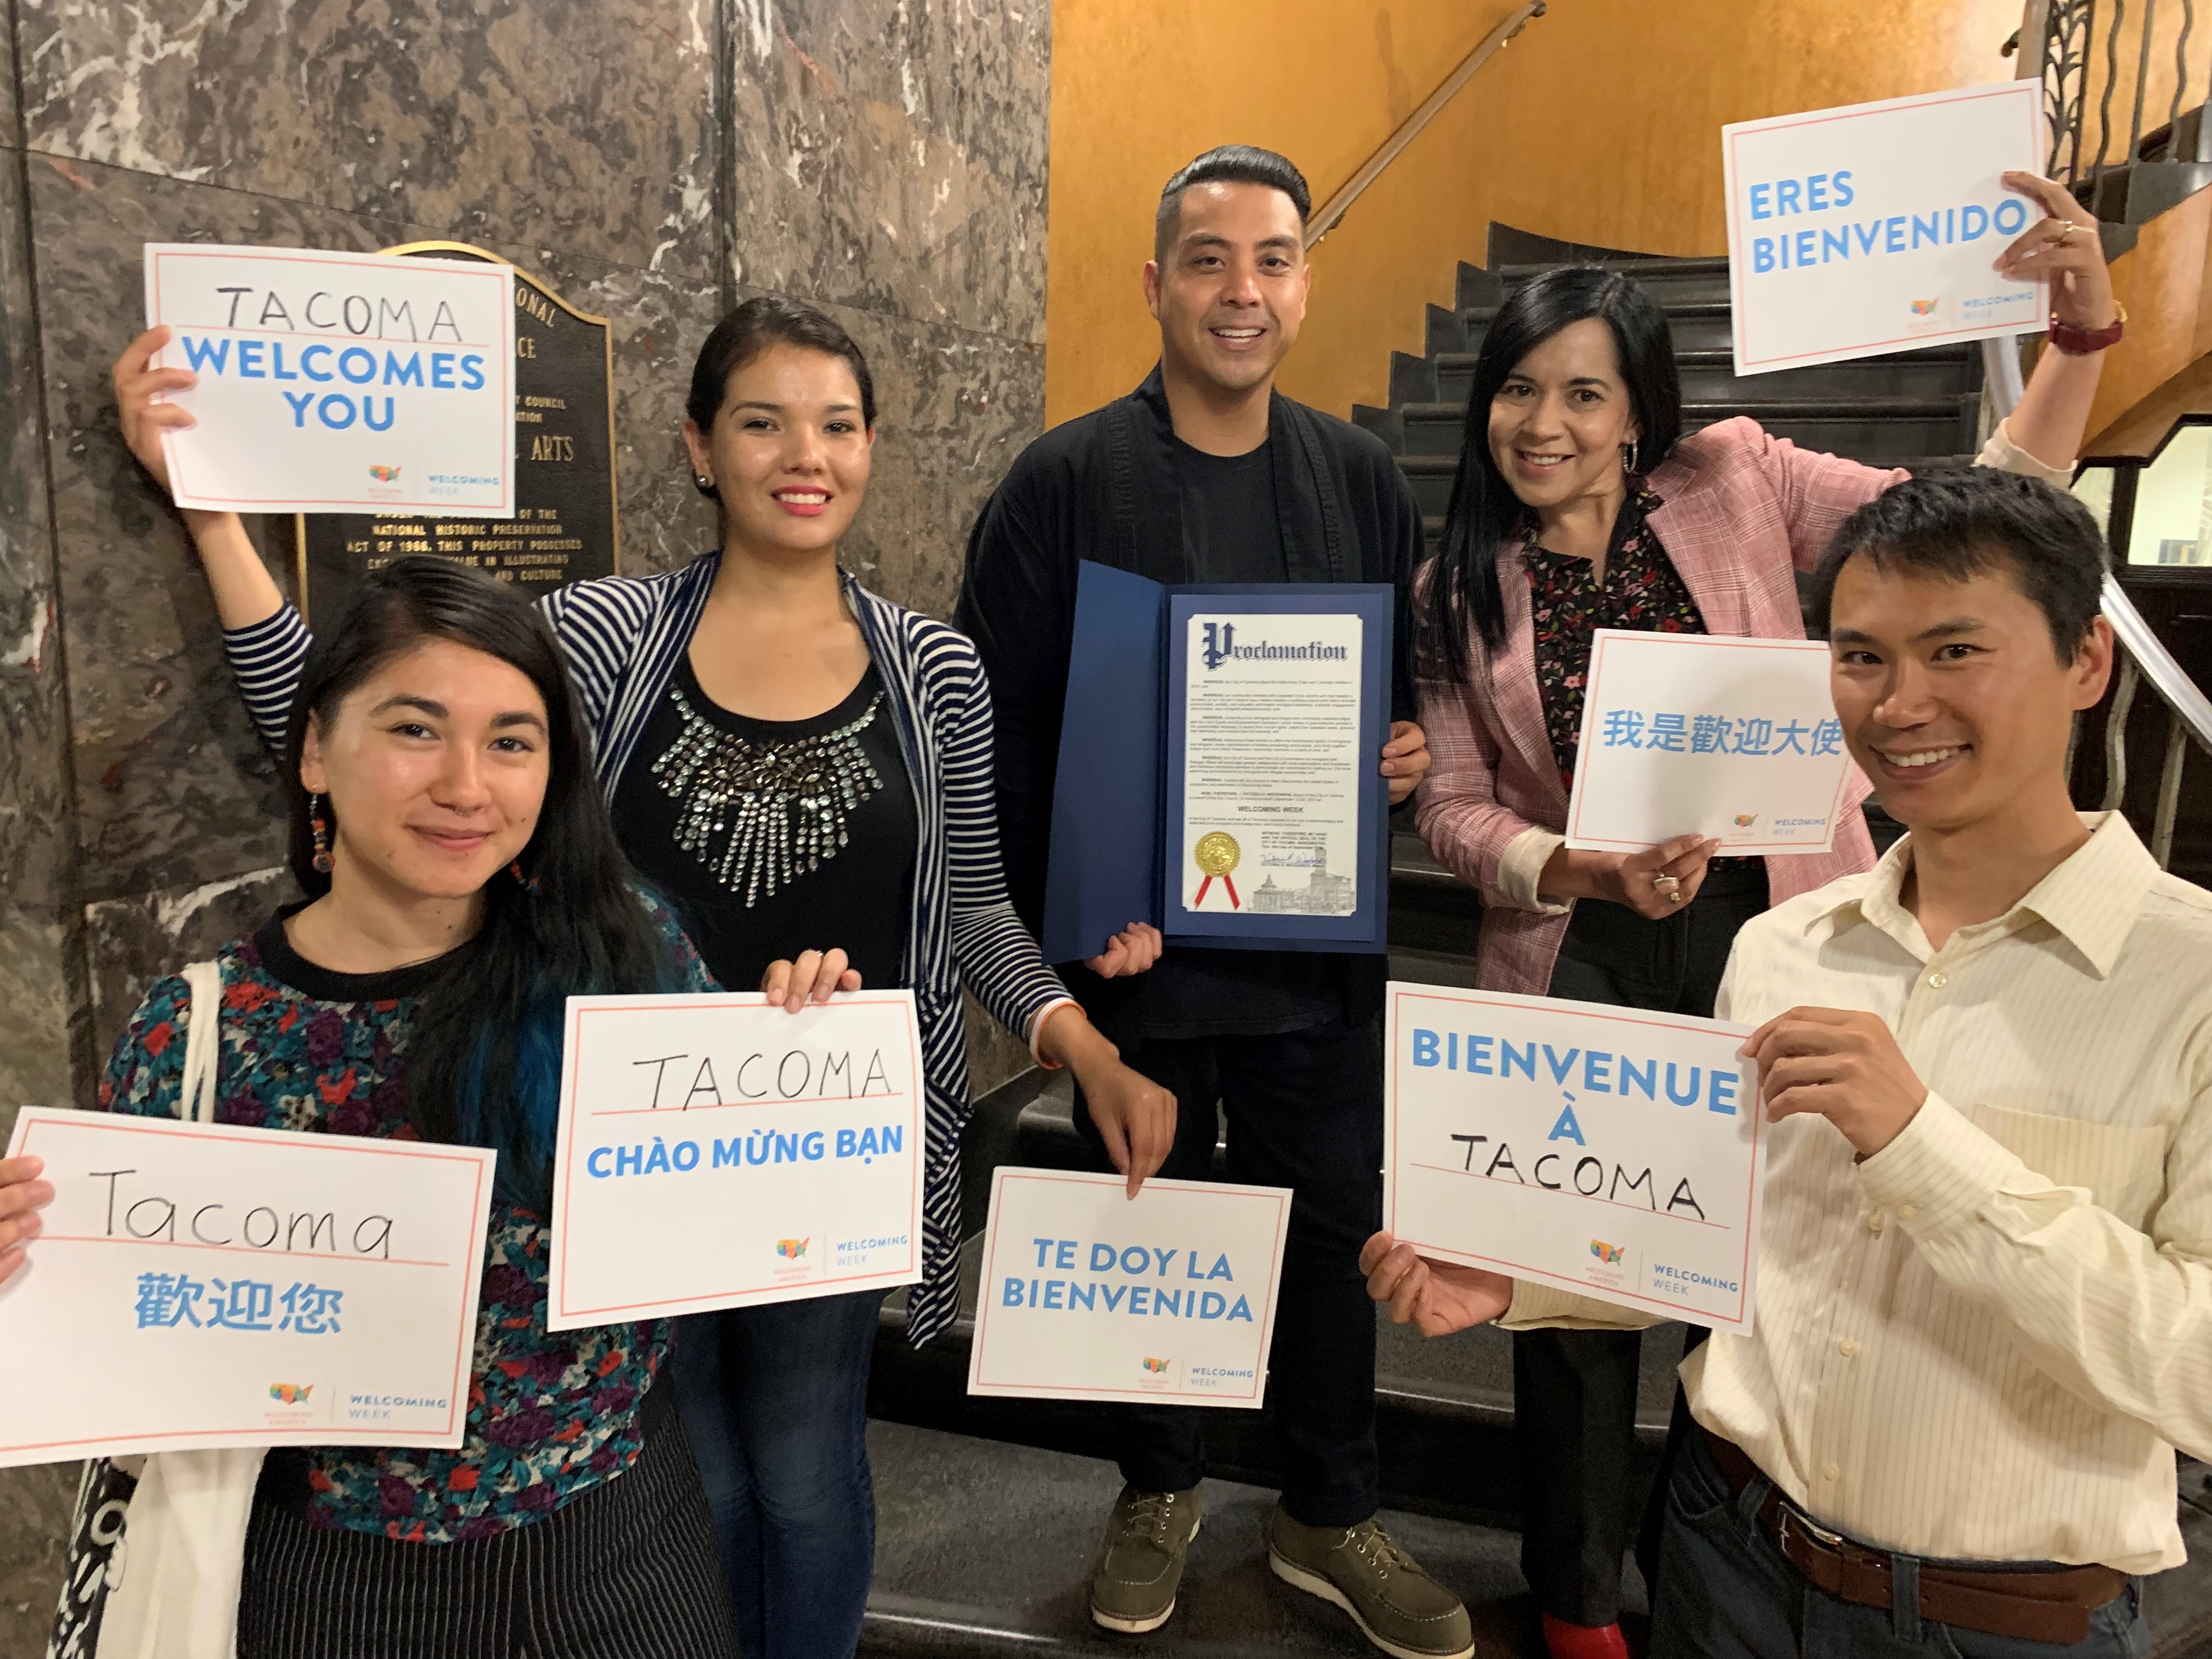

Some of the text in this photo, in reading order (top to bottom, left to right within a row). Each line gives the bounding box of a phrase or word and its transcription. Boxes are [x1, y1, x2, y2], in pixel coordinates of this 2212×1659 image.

[1750, 170, 1854, 220] ERES
[1753, 199, 2026, 274] BIENVENIDO
[217, 287, 463, 343] TACOMA
[182, 336, 485, 390] WELCOMES
[283, 391, 394, 432] YOU
[531, 436, 574, 461] ARTS
[1203, 622, 1348, 670] Proclamation
[1603, 710, 1844, 755] 我是歡迎大使
[633, 1048, 891, 1111] TACOMA
[1413, 1029, 1739, 1115] BIENVENUE
[1547, 1091, 1586, 1146] À
[586, 1125, 903, 1179] CHÀO MỪNG BẠN
[1451, 1133, 1705, 1221] TACOMA
[89, 1169, 393, 1260] Tacoma
[837, 1235, 908, 1251] WELCOMING
[837, 1254, 868, 1266] WEEK
[1034, 1239, 1233, 1282] TE DOY LA
[1002, 1278, 1254, 1322] BIENVENIDA
[1653, 1278, 1689, 1295] WEEK
[1654, 1264, 1738, 1292] WELCOMING
[134, 1272, 345, 1334] 歡迎您
[1191, 1378, 1217, 1387] WEEK
[1192, 1367, 1254, 1378] WELCOMING
[349, 1409, 391, 1419] WEEK
[350, 1395, 447, 1408] WELCOMING
